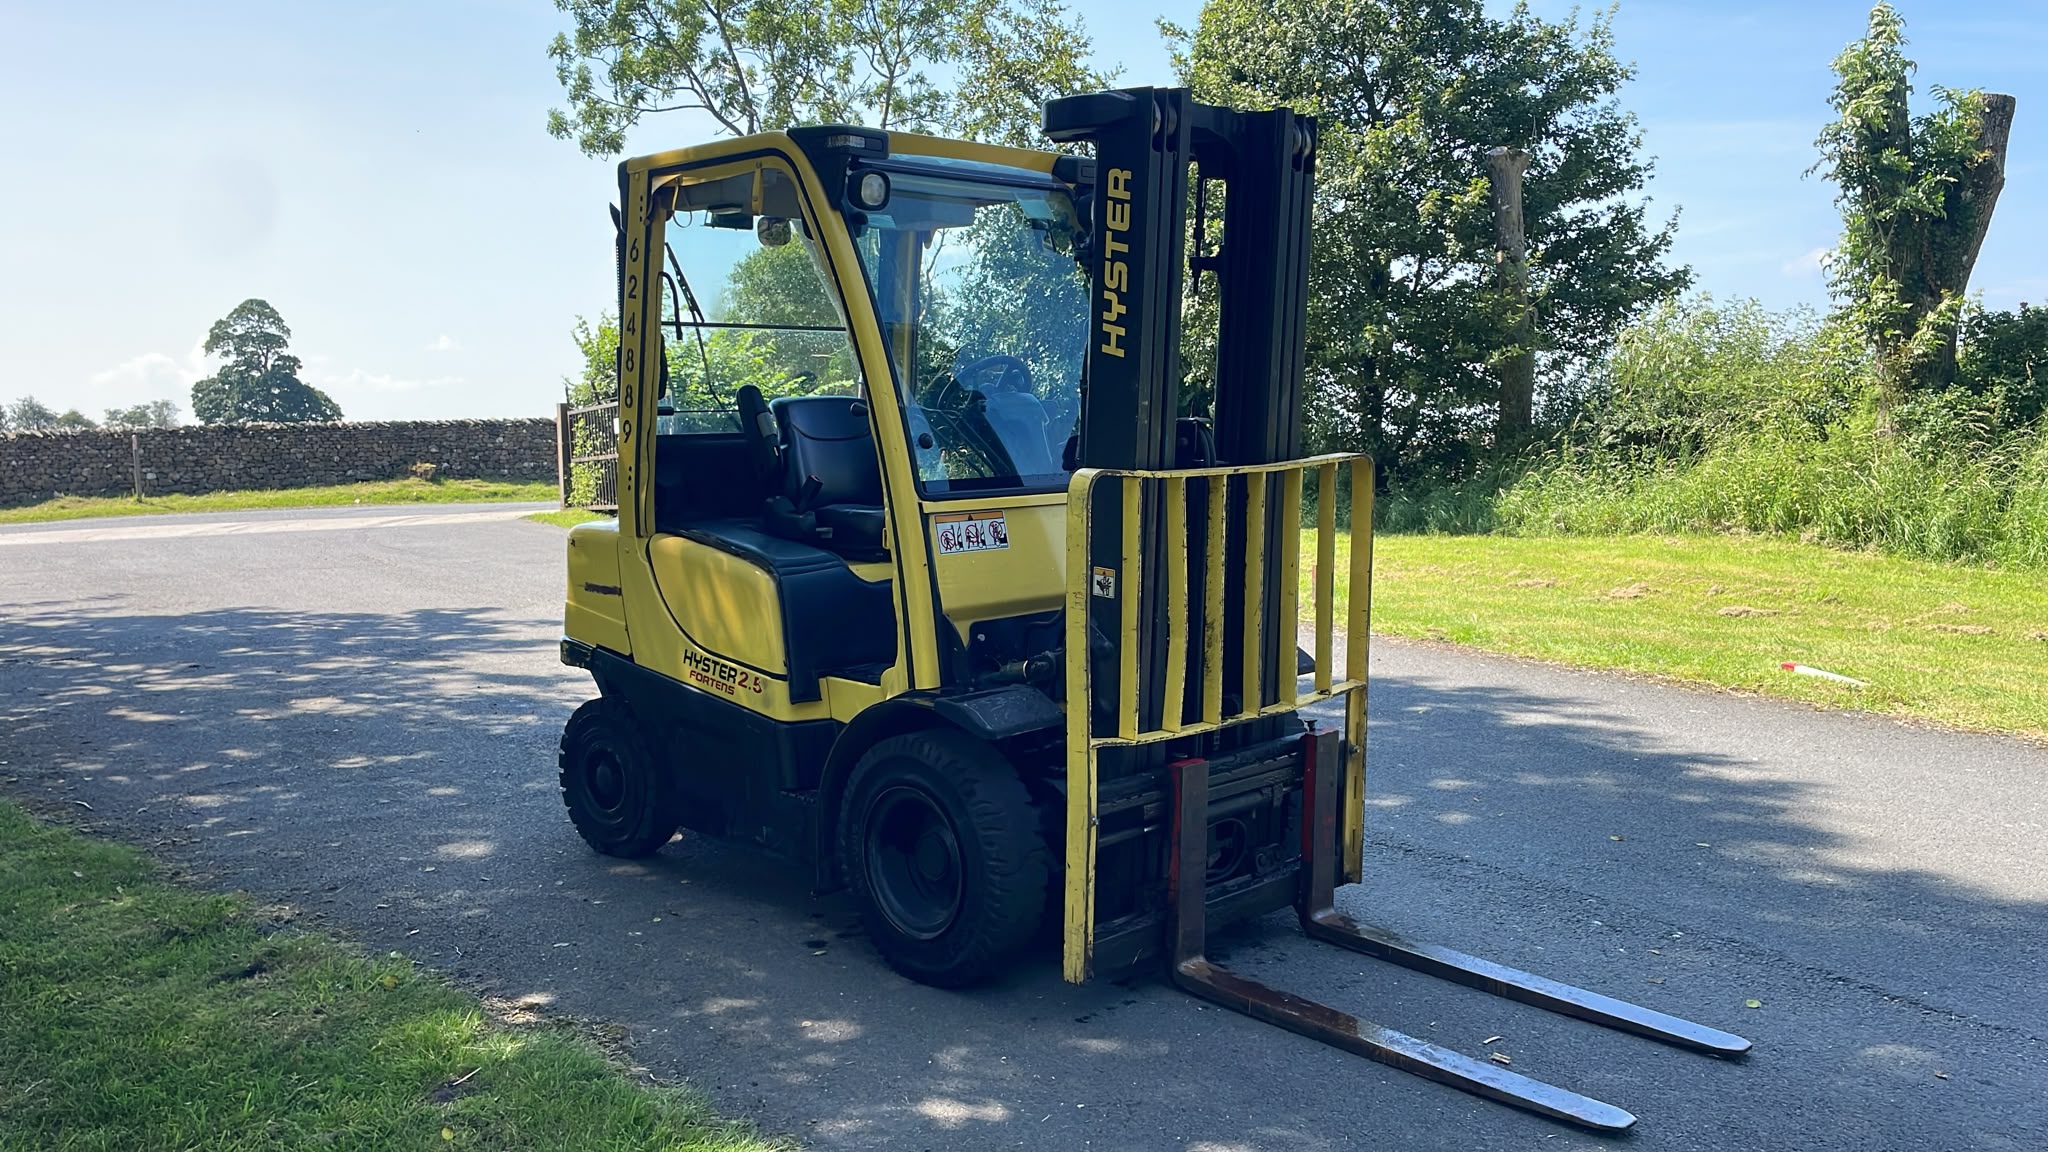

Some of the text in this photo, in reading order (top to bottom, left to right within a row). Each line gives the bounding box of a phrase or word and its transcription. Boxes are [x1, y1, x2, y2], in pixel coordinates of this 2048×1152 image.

[1101, 167, 1132, 358] HYSTER
[622, 237, 639, 444] 624889
[683, 649, 763, 694] HYSTER 2.5
[689, 669, 736, 696] FORTENS
